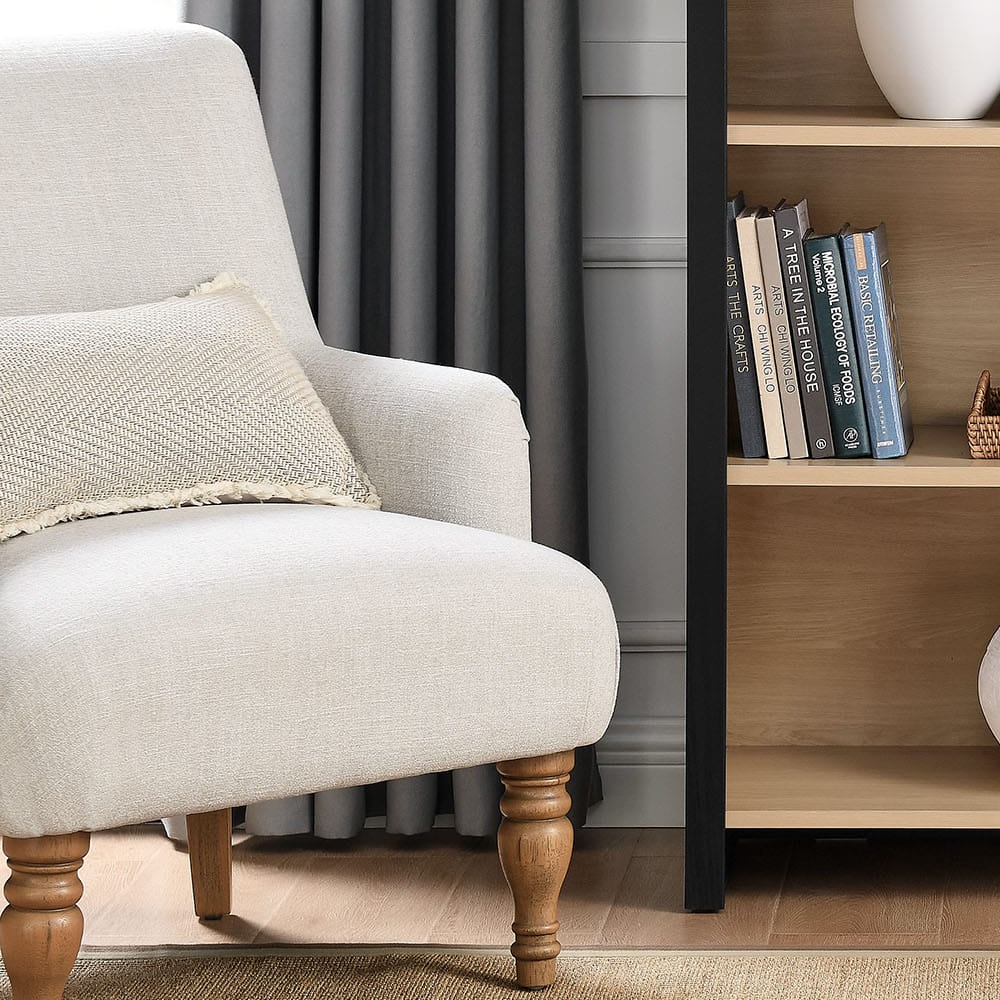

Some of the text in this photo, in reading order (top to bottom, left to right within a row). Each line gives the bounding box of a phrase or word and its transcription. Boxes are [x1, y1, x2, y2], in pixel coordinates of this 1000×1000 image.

[726, 256, 749, 373] ARTS THE CRAFTS
[781, 228, 819, 393] A TREE IN THE HOUSE
[811, 254, 824, 286] Volume
[858, 275, 873, 312] BASIC
[751, 285, 775, 393] ARTS CHI WING LO
[771, 285, 796, 394] ARTS CHI WING LO
[822, 251, 855, 405] MICROBIAL ECOLOGY OF FOODS
[863, 312, 883, 384] RETAILING
[832, 383, 843, 406] ICMSF
